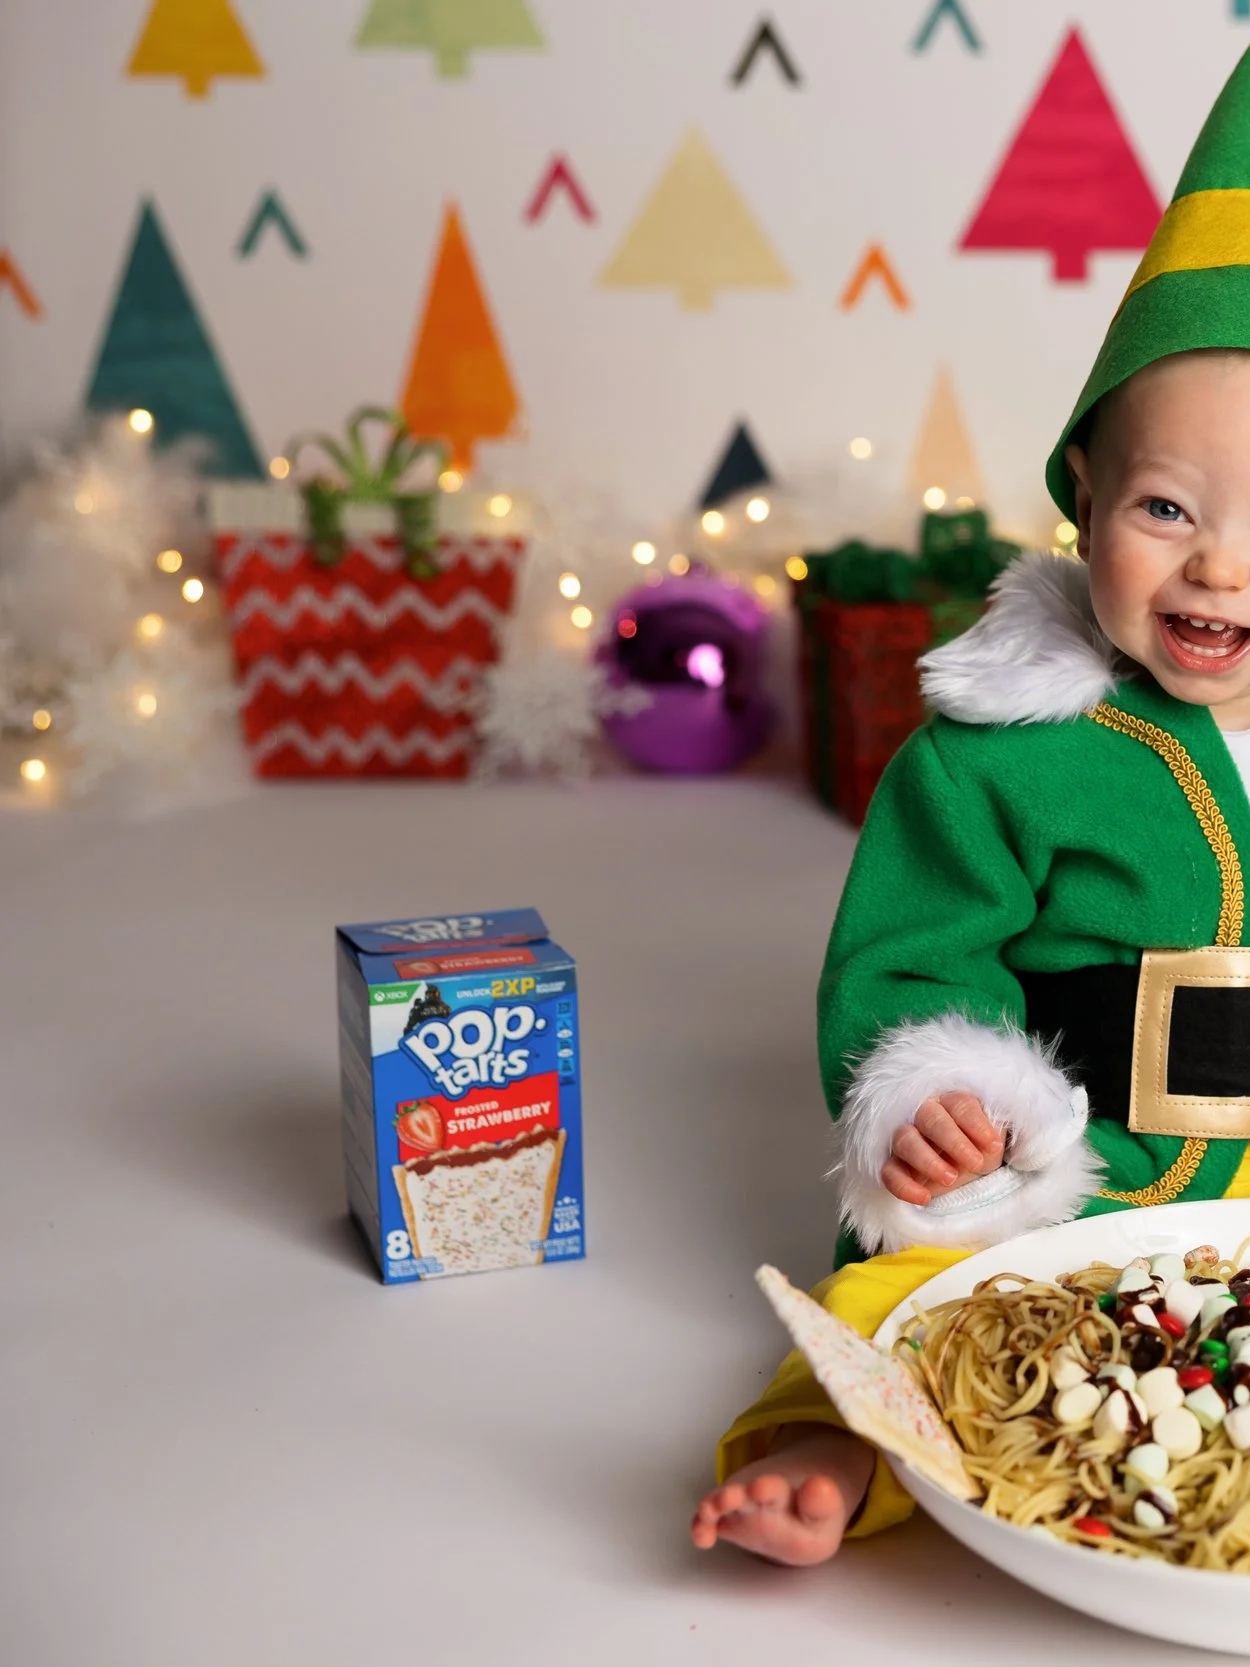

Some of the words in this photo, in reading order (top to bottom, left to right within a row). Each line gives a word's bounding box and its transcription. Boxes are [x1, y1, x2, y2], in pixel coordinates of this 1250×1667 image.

[386, 991, 408, 1000] XBOX
[456, 988, 491, 999] UNLOCK
[491, 977, 535, 998] 2XP
[434, 1049, 530, 1096] tarts
[447, 1101, 551, 1135] STRAWBERRY
[454, 1101, 499, 1117] FROSTED
[554, 1217, 581, 1233] USA
[386, 1229, 411, 1260] 8
